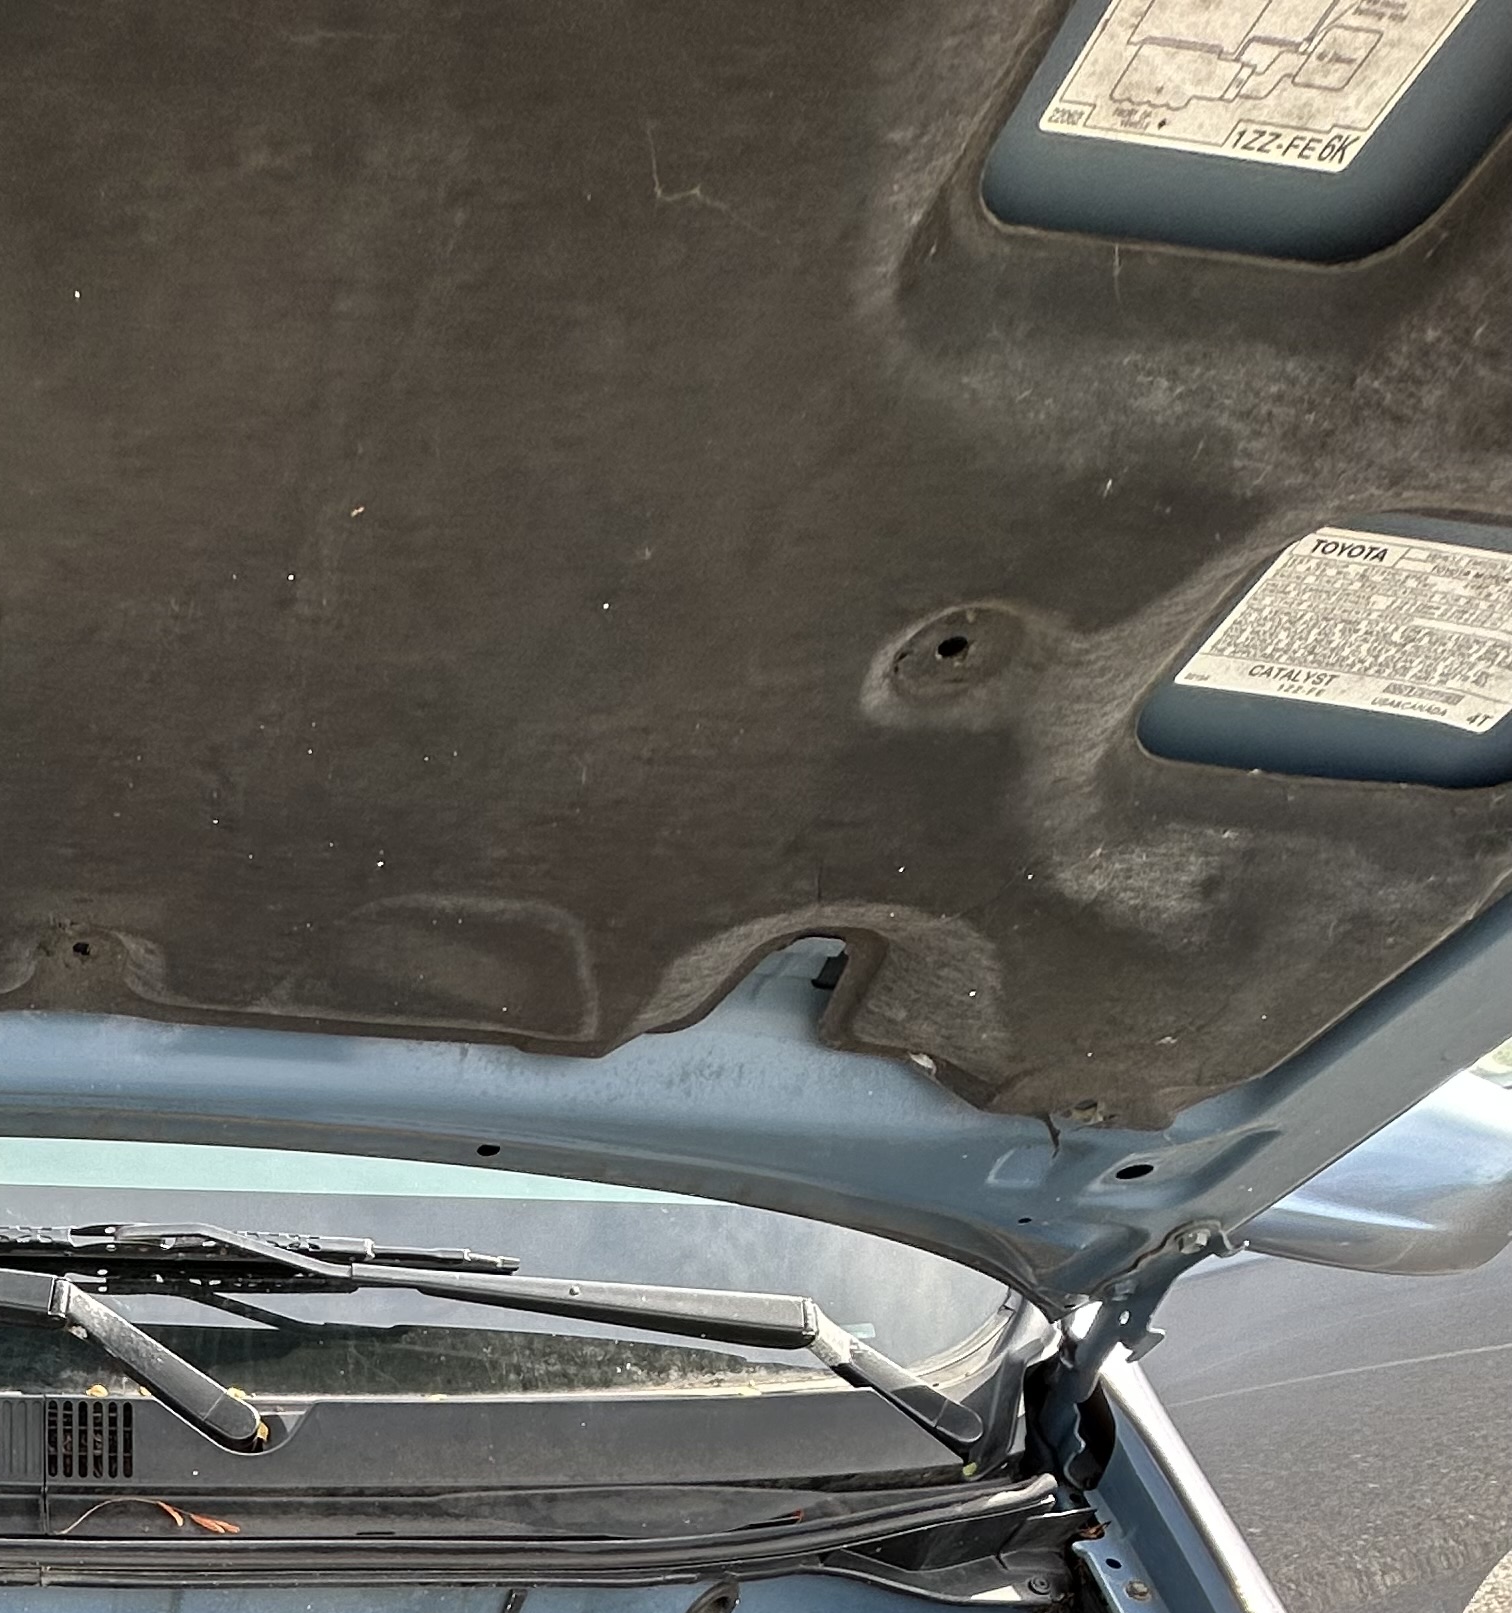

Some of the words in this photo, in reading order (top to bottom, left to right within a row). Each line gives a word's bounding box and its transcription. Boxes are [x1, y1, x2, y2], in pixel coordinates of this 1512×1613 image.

[1317, 134, 1361, 164] 6K
[1311, 538, 1388, 562] TOYOTA
[1248, 664, 1340, 687] CATALYST
